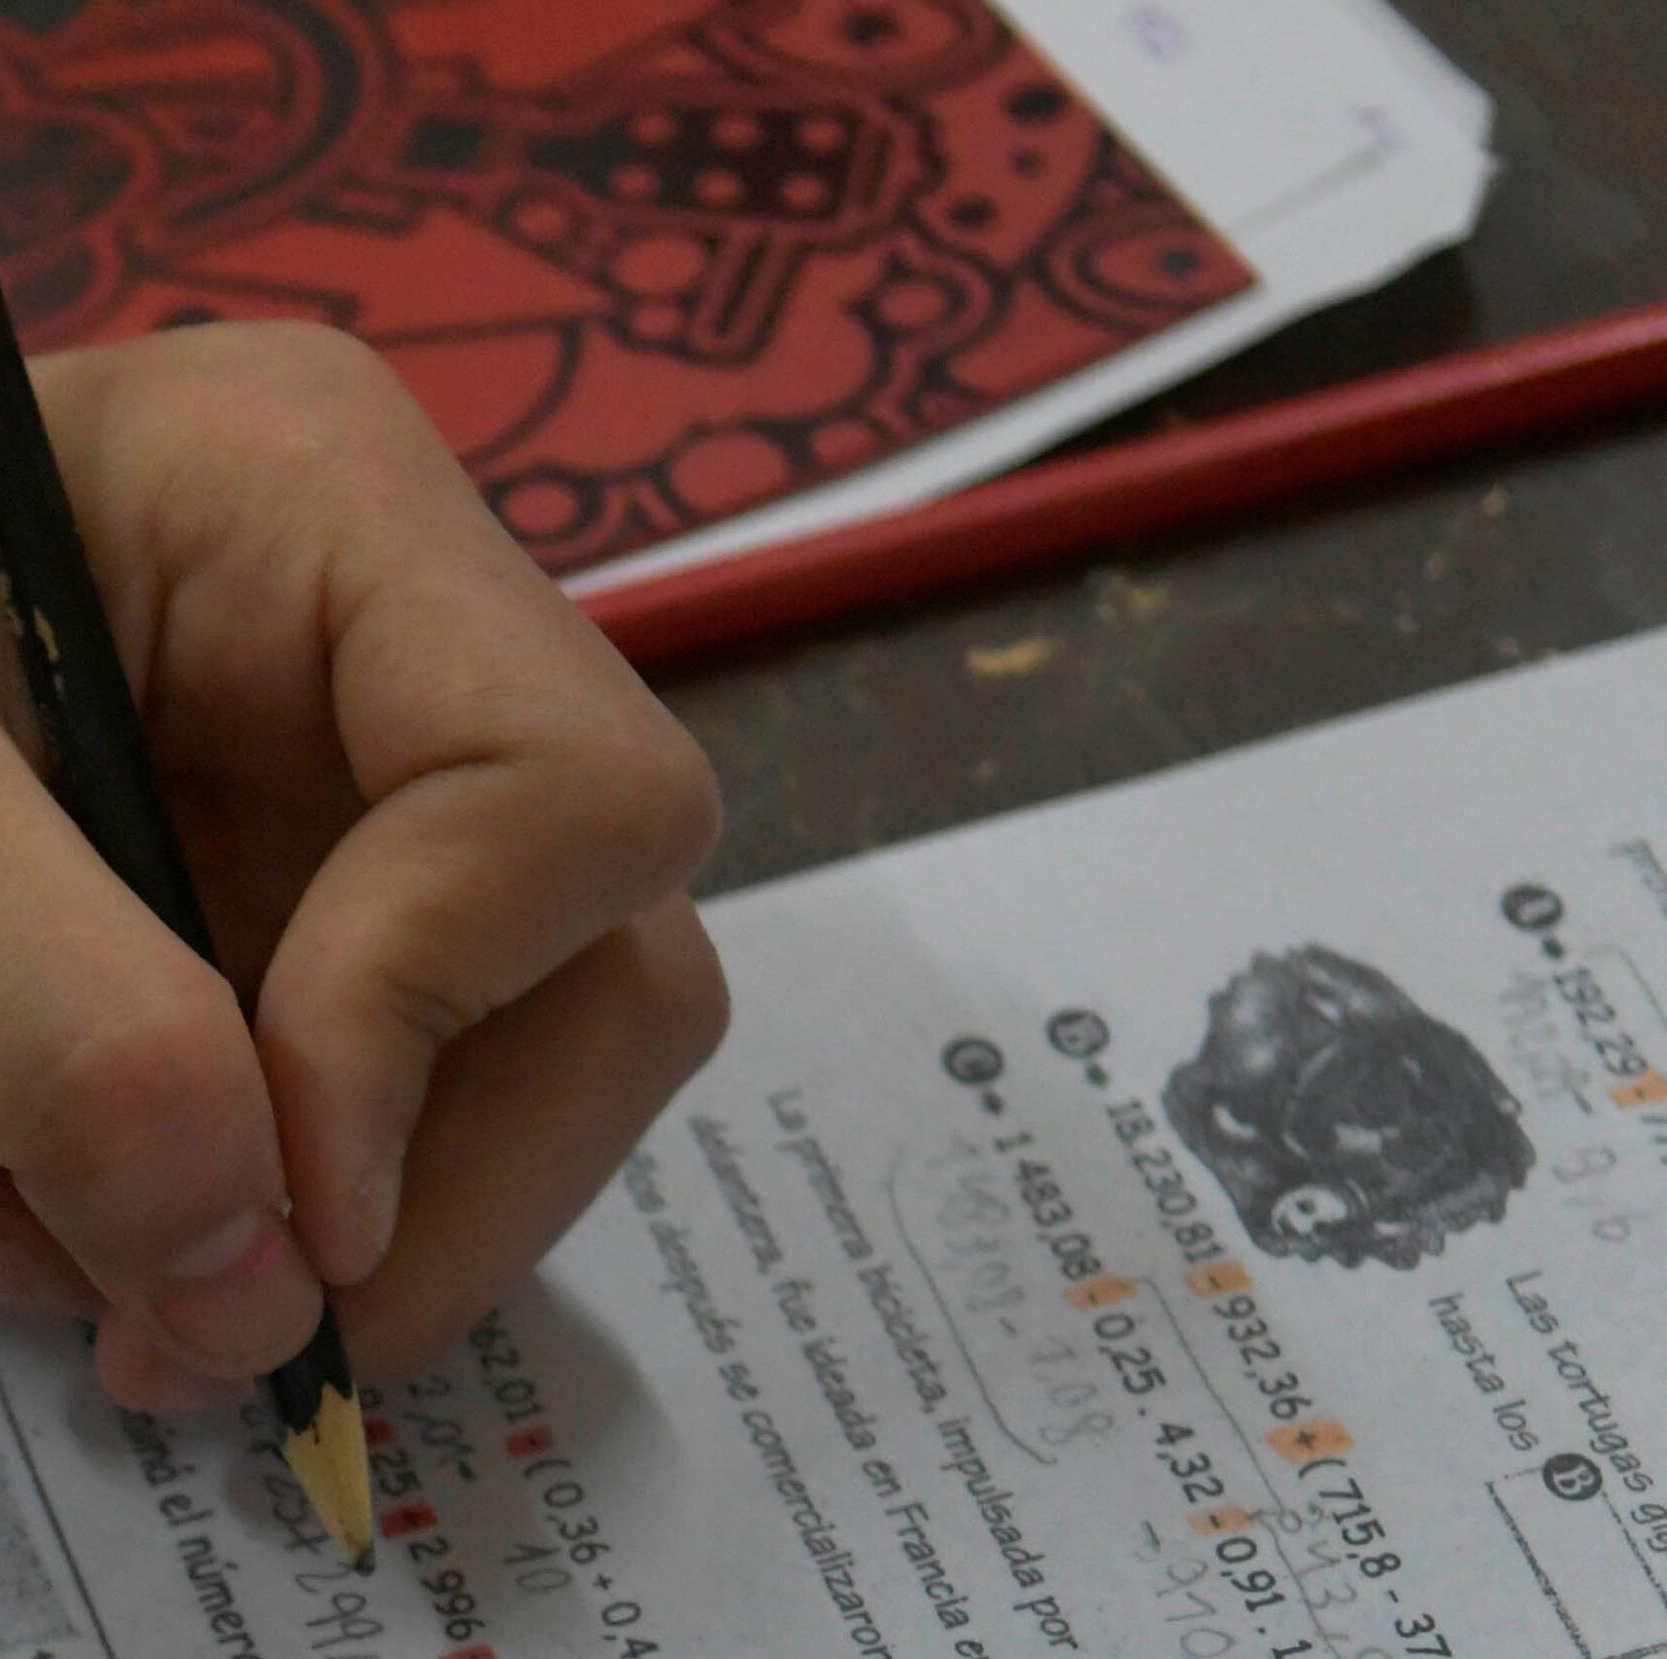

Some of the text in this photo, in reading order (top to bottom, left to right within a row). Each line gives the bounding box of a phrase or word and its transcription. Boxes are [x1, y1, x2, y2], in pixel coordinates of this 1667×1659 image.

[718, 1361, 760, 1401] se
[1211, 1294, 1312, 1421] 932,36
[1427, 1291, 1505, 1395] hasta
[1491, 1397, 1540, 1452] los
[1504, 1270, 1560, 1335] Las
[1546, 1339, 1654, 1493] tortugas
[158, 1492, 214, 1526] el
[801, 1336, 877, 1451] ideada
[860, 1458, 902, 1497] en
[884, 1500, 970, 1630] Francia
[935, 1415, 1045, 1589] impulsada
[1011, 1594, 1079, 1650] por
[1092, 1312, 1167, 1395] 0,25
[1154, 1422, 1225, 1504] 4,32
[1214, 1535, 1286, 1613] 0,91
